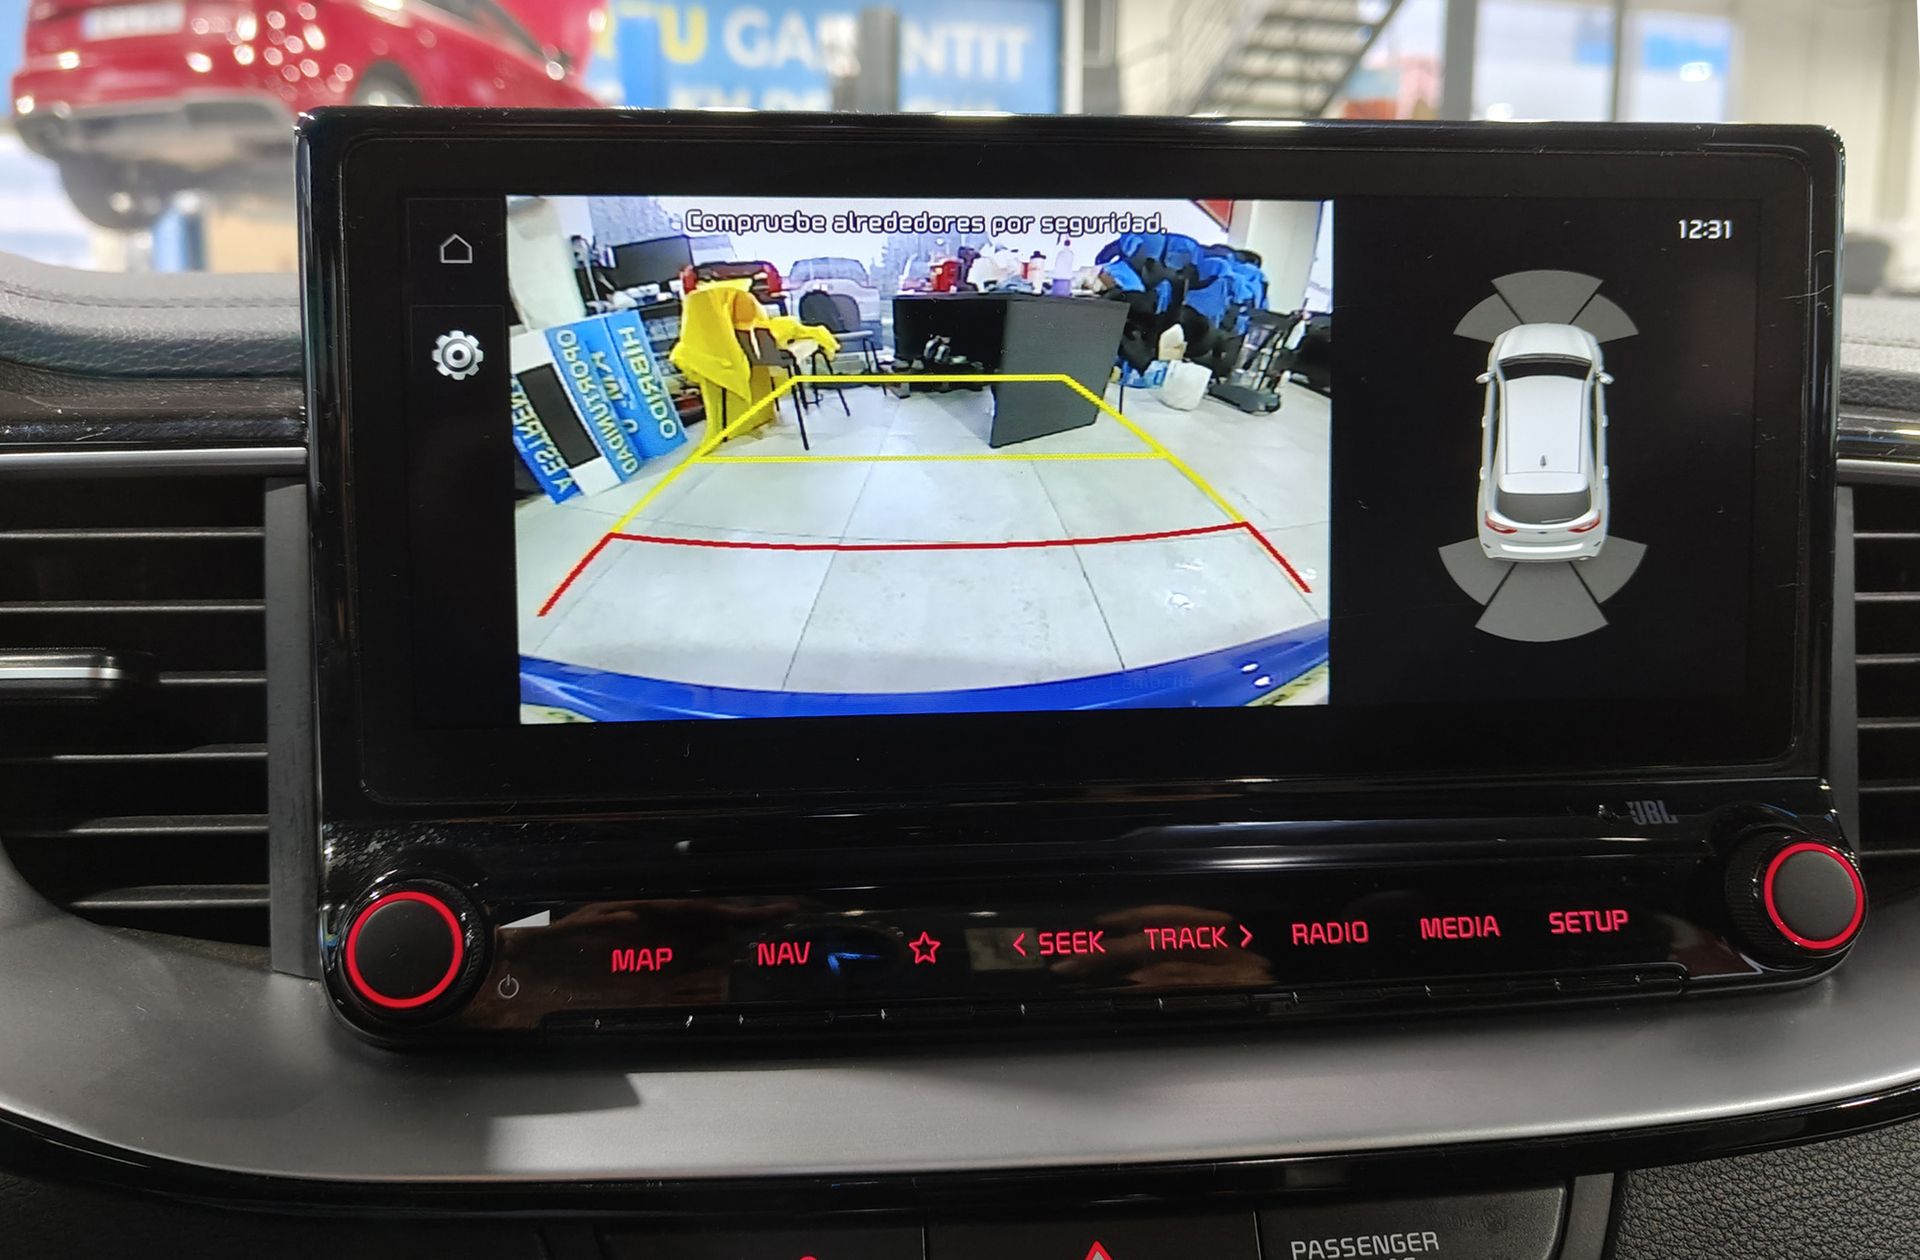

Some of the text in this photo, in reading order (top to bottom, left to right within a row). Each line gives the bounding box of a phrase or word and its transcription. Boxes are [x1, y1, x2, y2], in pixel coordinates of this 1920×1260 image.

[685, 209, 1168, 237] Compruebe alrededores por seguridad.
[1678, 219, 1733, 239] 12:31
[1625, 799, 1679, 825] JBL
[1291, 920, 1369, 946] RADIO
[1420, 915, 1501, 940] MEDIA
[1549, 909, 1629, 934] SETUP
[1038, 930, 1106, 956] SEEK
[1144, 926, 1228, 951] TRACK
[611, 947, 673, 973] MAP
[757, 941, 811, 966] NAV
[1290, 1231, 1440, 1260] PASSENGER
